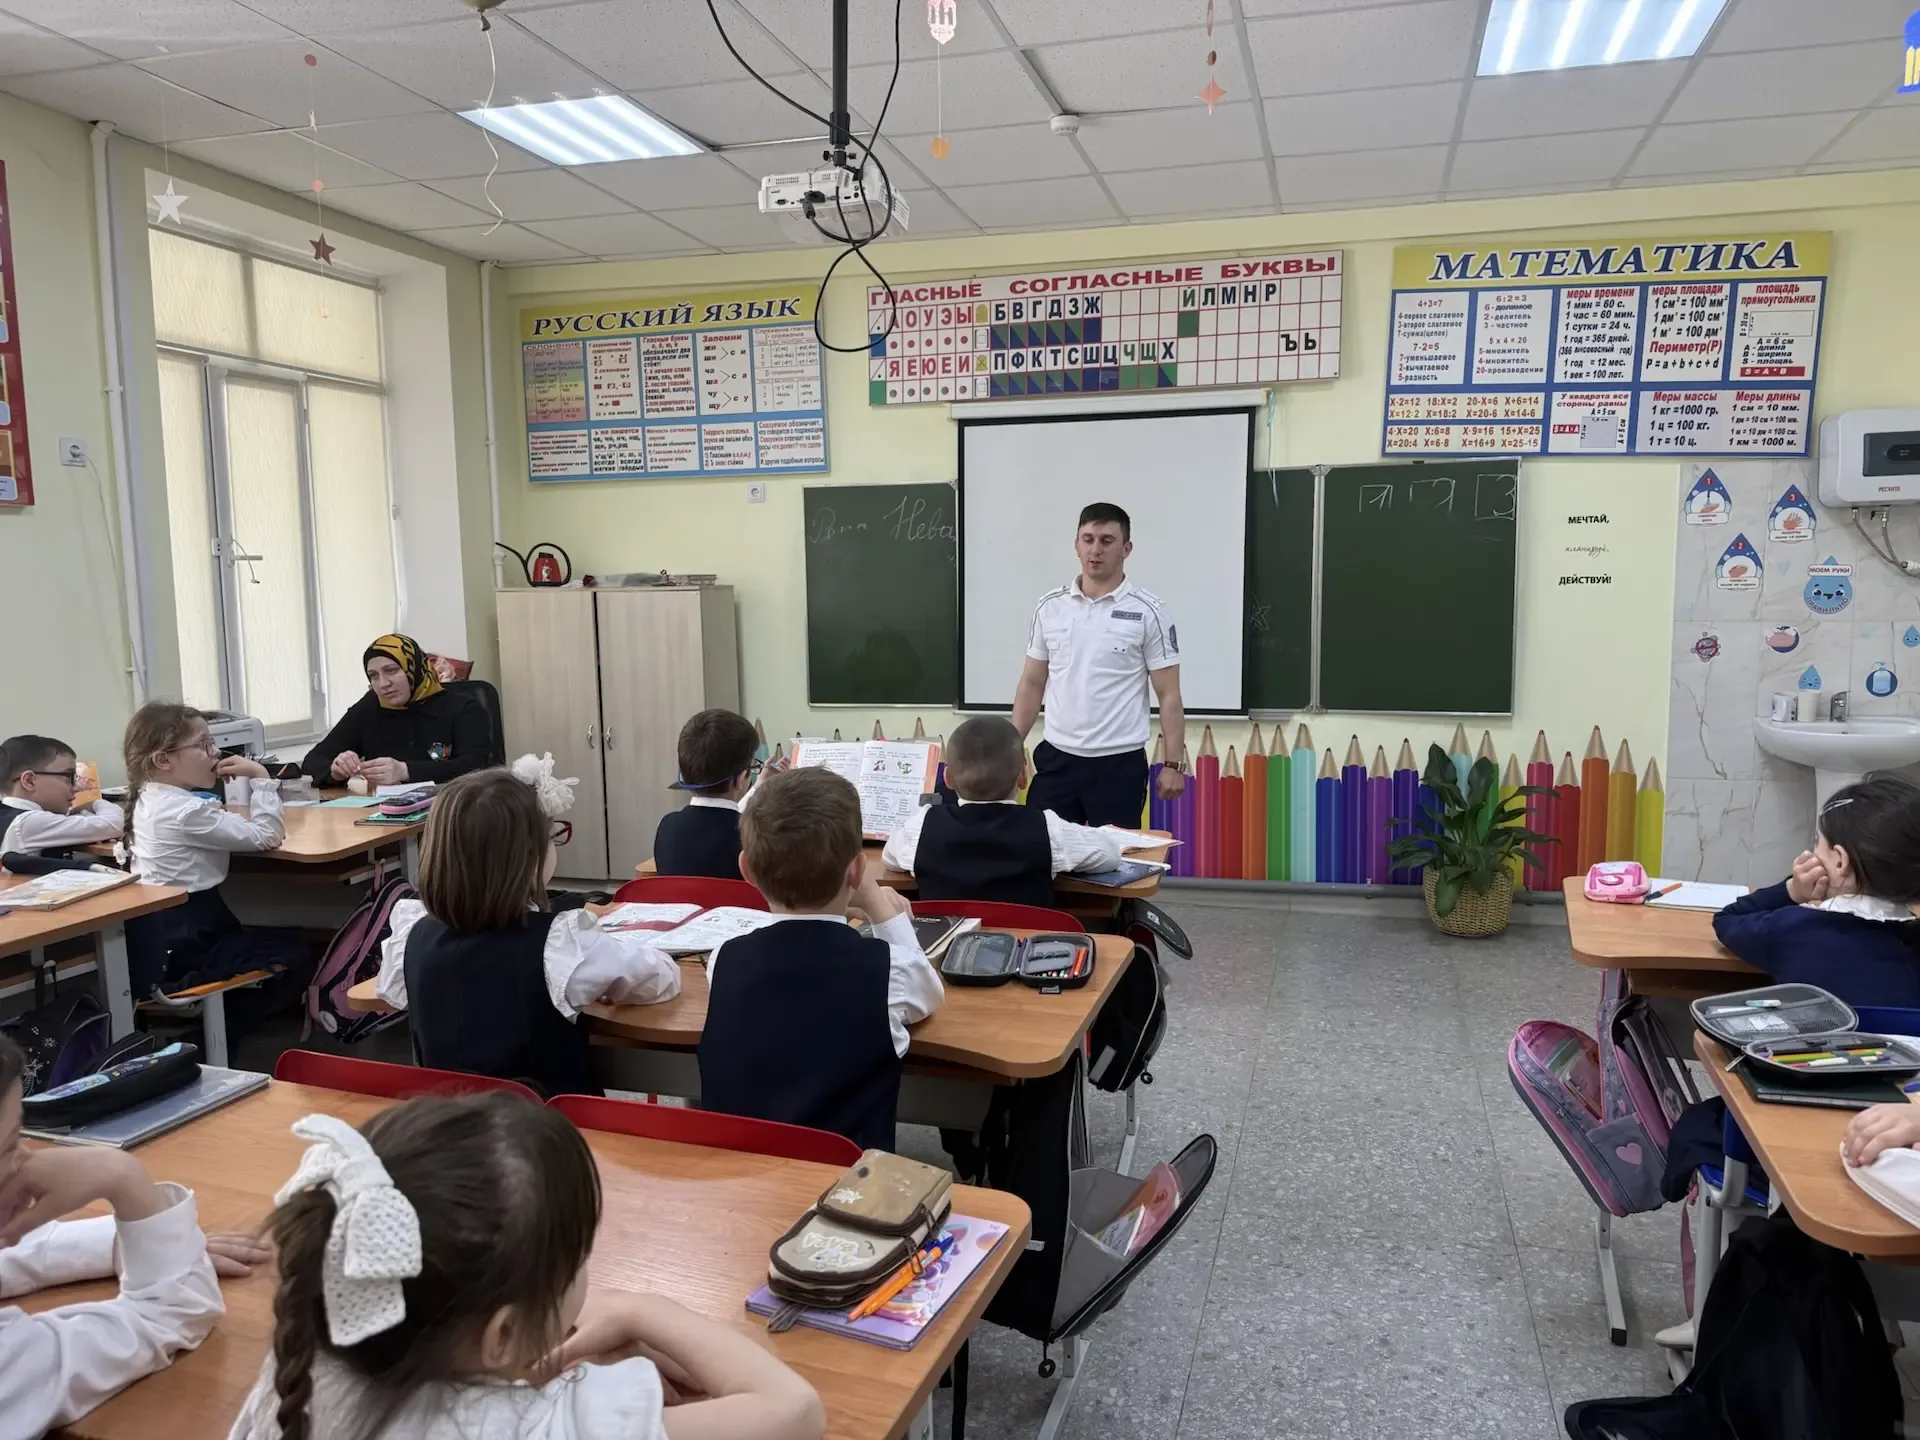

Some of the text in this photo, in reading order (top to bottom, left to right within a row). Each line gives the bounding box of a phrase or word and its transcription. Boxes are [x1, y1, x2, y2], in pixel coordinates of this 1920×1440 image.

[1428, 242, 1799, 280] МАТЕМАТИКА
[1009, 257, 1335, 294] СОГЛАСНЫЕ БУКВЫ
[871, 284, 982, 305] ГЛАСНЫЕ
[1567, 288, 1635, 301] меры времени
[1652, 285, 1723, 297] меры площади
[1756, 284, 1800, 294] площадь
[995, 304, 1006, 322] Б
[1012, 302, 1023, 320] В
[1032, 301, 1042, 318] Г
[1049, 300, 1062, 319] Д
[1084, 296, 1100, 315] Ж
[1182, 286, 1195, 307] Й
[1202, 288, 1215, 306] Л
[1221, 286, 1236, 305] М
[1244, 285, 1256, 303] Н
[1265, 283, 1277, 302] Р
[1418, 300, 1443, 308] 4+3=7
[1574, 301, 1592, 309] мин
[1603, 299, 1614, 308] 60
[1741, 295, 1816, 307] прямоугольника
[532, 298, 800, 335] РУССКИЙ ЯЗЫК
[905, 310, 917, 328] О
[924, 308, 934, 326] У
[941, 308, 952, 325] Э
[956, 306, 972, 324] Ы
[1600, 310, 1611, 319] 60
[1572, 323, 1598, 332] сутки
[1609, 321, 1620, 330] 24
[702, 334, 742, 342] Запомни
[994, 353, 1005, 370] П
[1011, 352, 1025, 369] Ф
[1032, 350, 1042, 368] К
[1050, 350, 1061, 366] Т
[1068, 348, 1078, 365] С
[1084, 347, 1099, 364] Ш
[1104, 346, 1118, 365] Ц
[1123, 344, 1135, 361] Ч
[1141, 343, 1156, 362] Щ
[1281, 334, 1298, 352] Ъ
[1305, 332, 1317, 350] Ь
[889, 361, 899, 378] Я
[922, 357, 936, 374] Ю
[942, 357, 951, 374] Е
[958, 355, 970, 373] И
[1476, 367, 1544, 375] 20-произведение
[1398, 373, 1438, 382] 5-разность
[1653, 392, 1717, 403] Меры массы
[1736, 392, 1800, 403] Меры длины
[1652, 405, 1657, 414] 1
[1660, 406, 1670, 415] кг
[1705, 406, 1719, 416] гр.
[1568, 514, 1610, 524] МЕЧТАЙ,
[1558, 574, 1612, 586] ДЕЙСТВУЙ!
[1806, 597, 1849, 613] ПРАВИЛЬНО
